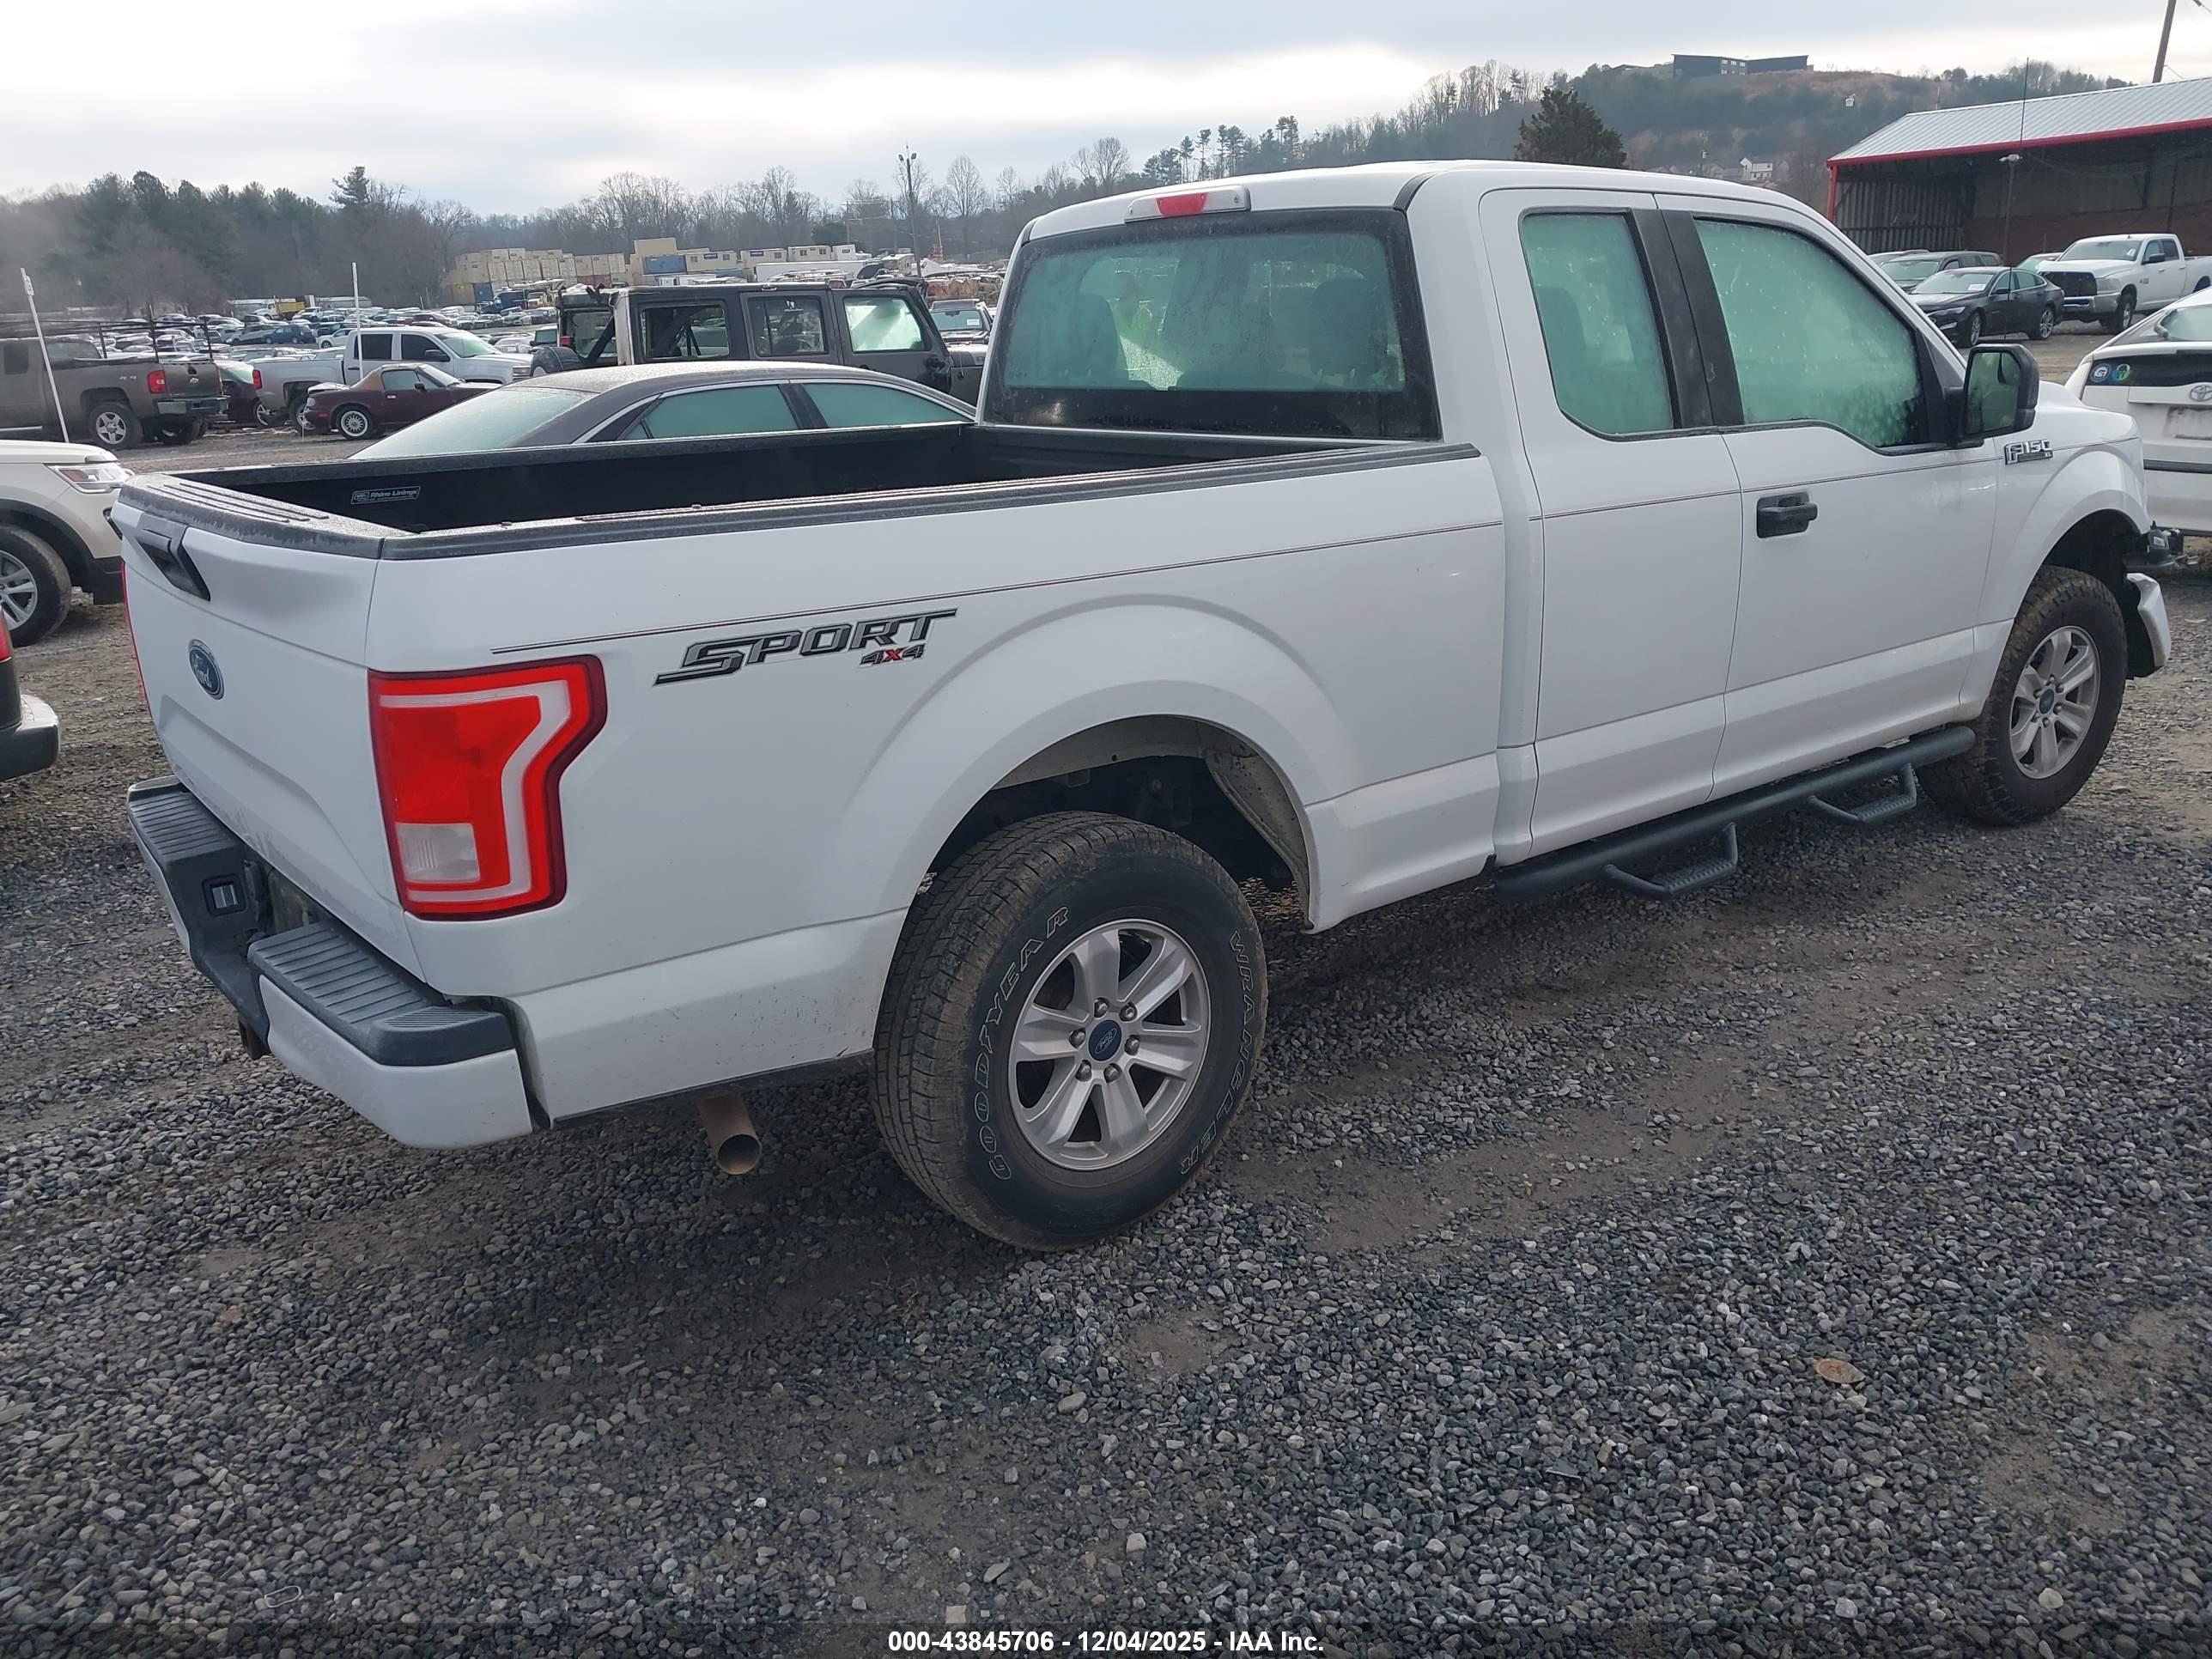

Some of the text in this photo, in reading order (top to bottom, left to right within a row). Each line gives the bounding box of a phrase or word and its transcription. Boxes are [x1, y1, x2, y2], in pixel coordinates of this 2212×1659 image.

[653, 607, 958, 687] SPORT
[860, 643, 926, 666] 4x4
[974, 906, 1069, 1181] GOODYEAR
[1180, 930, 1255, 1175] WRANGLER
